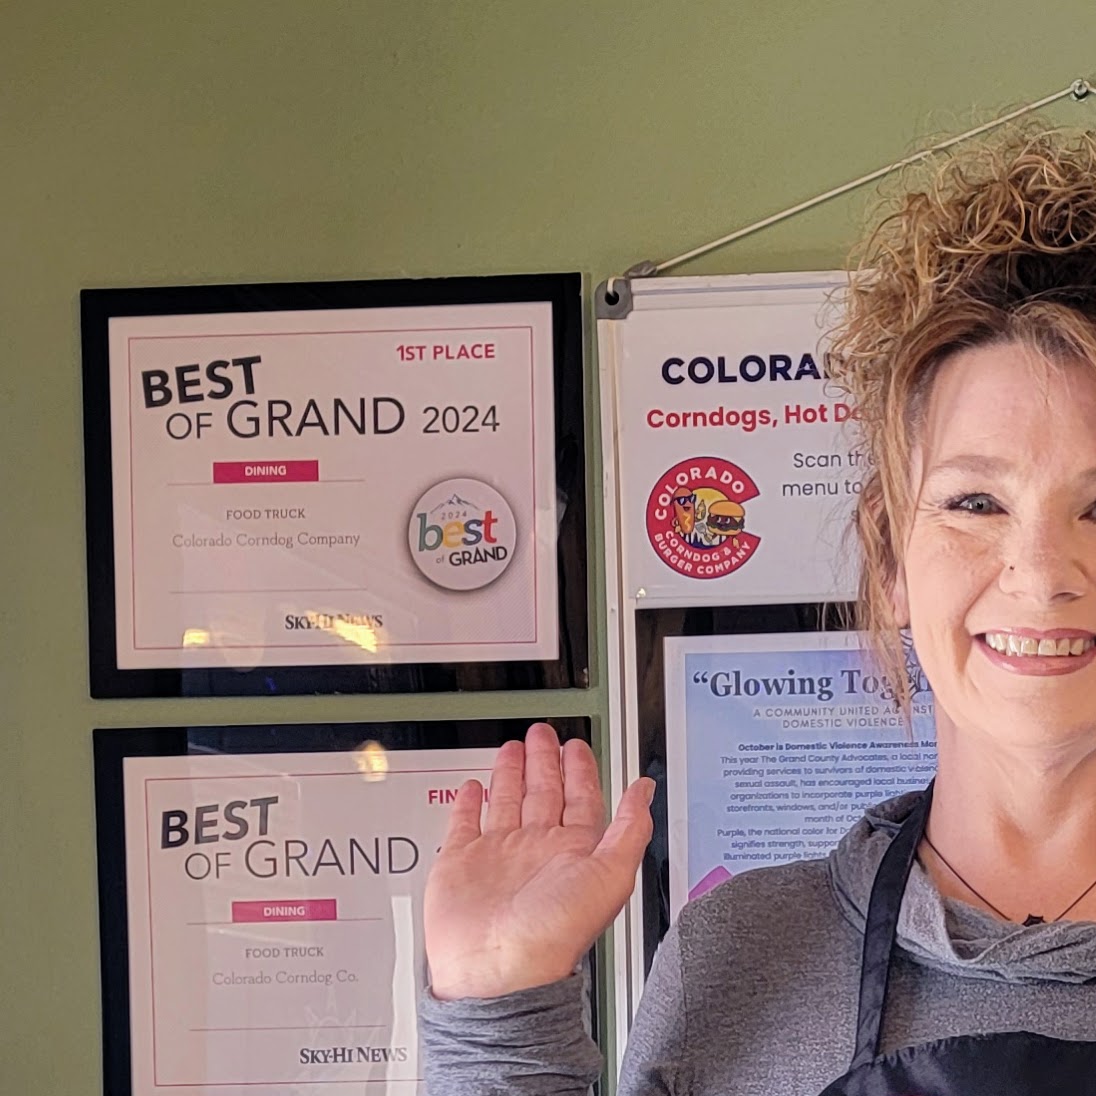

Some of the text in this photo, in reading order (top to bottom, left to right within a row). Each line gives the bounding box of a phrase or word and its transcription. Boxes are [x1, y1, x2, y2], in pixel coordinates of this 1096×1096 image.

[396, 344, 495, 361] 1ST PLACE
[661, 353, 831, 385] COLORA
[141, 355, 262, 409] BEST
[166, 397, 500, 440] OF GRAND 2024
[647, 406, 778, 432] Corndogs,
[784, 404, 828, 425] Hot
[793, 452, 841, 469] Scan
[244, 465, 286, 477] DINING
[654, 466, 745, 521] COLORADO
[782, 481, 838, 497] menu
[844, 479, 863, 495] to
[226, 508, 306, 520] FOOD TRUCK
[417, 510, 498, 551] best
[172, 532, 360, 550] Colorado Corndog Company
[665, 530, 720, 562] CORNDOG
[448, 546, 507, 566] GRAND
[654, 533, 751, 575] BURGER COMPANY
[753, 709, 761, 717] A
[765, 707, 834, 717] COMMUNITY
[840, 706, 879, 716] UNITED
[783, 718, 904, 729] DOMESTIC VIOLENCE
[738, 743, 775, 752] October
[785, 742, 828, 751] Domestic
[829, 741, 868, 750] Violence
[778, 754, 840, 764] Grand County
[723, 767, 802, 777] providing services
[160, 796, 278, 849] BEST
[717, 829, 746, 837] Purple,
[184, 837, 419, 880] OF GRAND
[723, 852, 802, 861] illuminated purple
[263, 905, 305, 917] DINING
[245, 946, 324, 958] FOOD TRUCK
[212, 970, 359, 987] Colorado Corndog Co.
